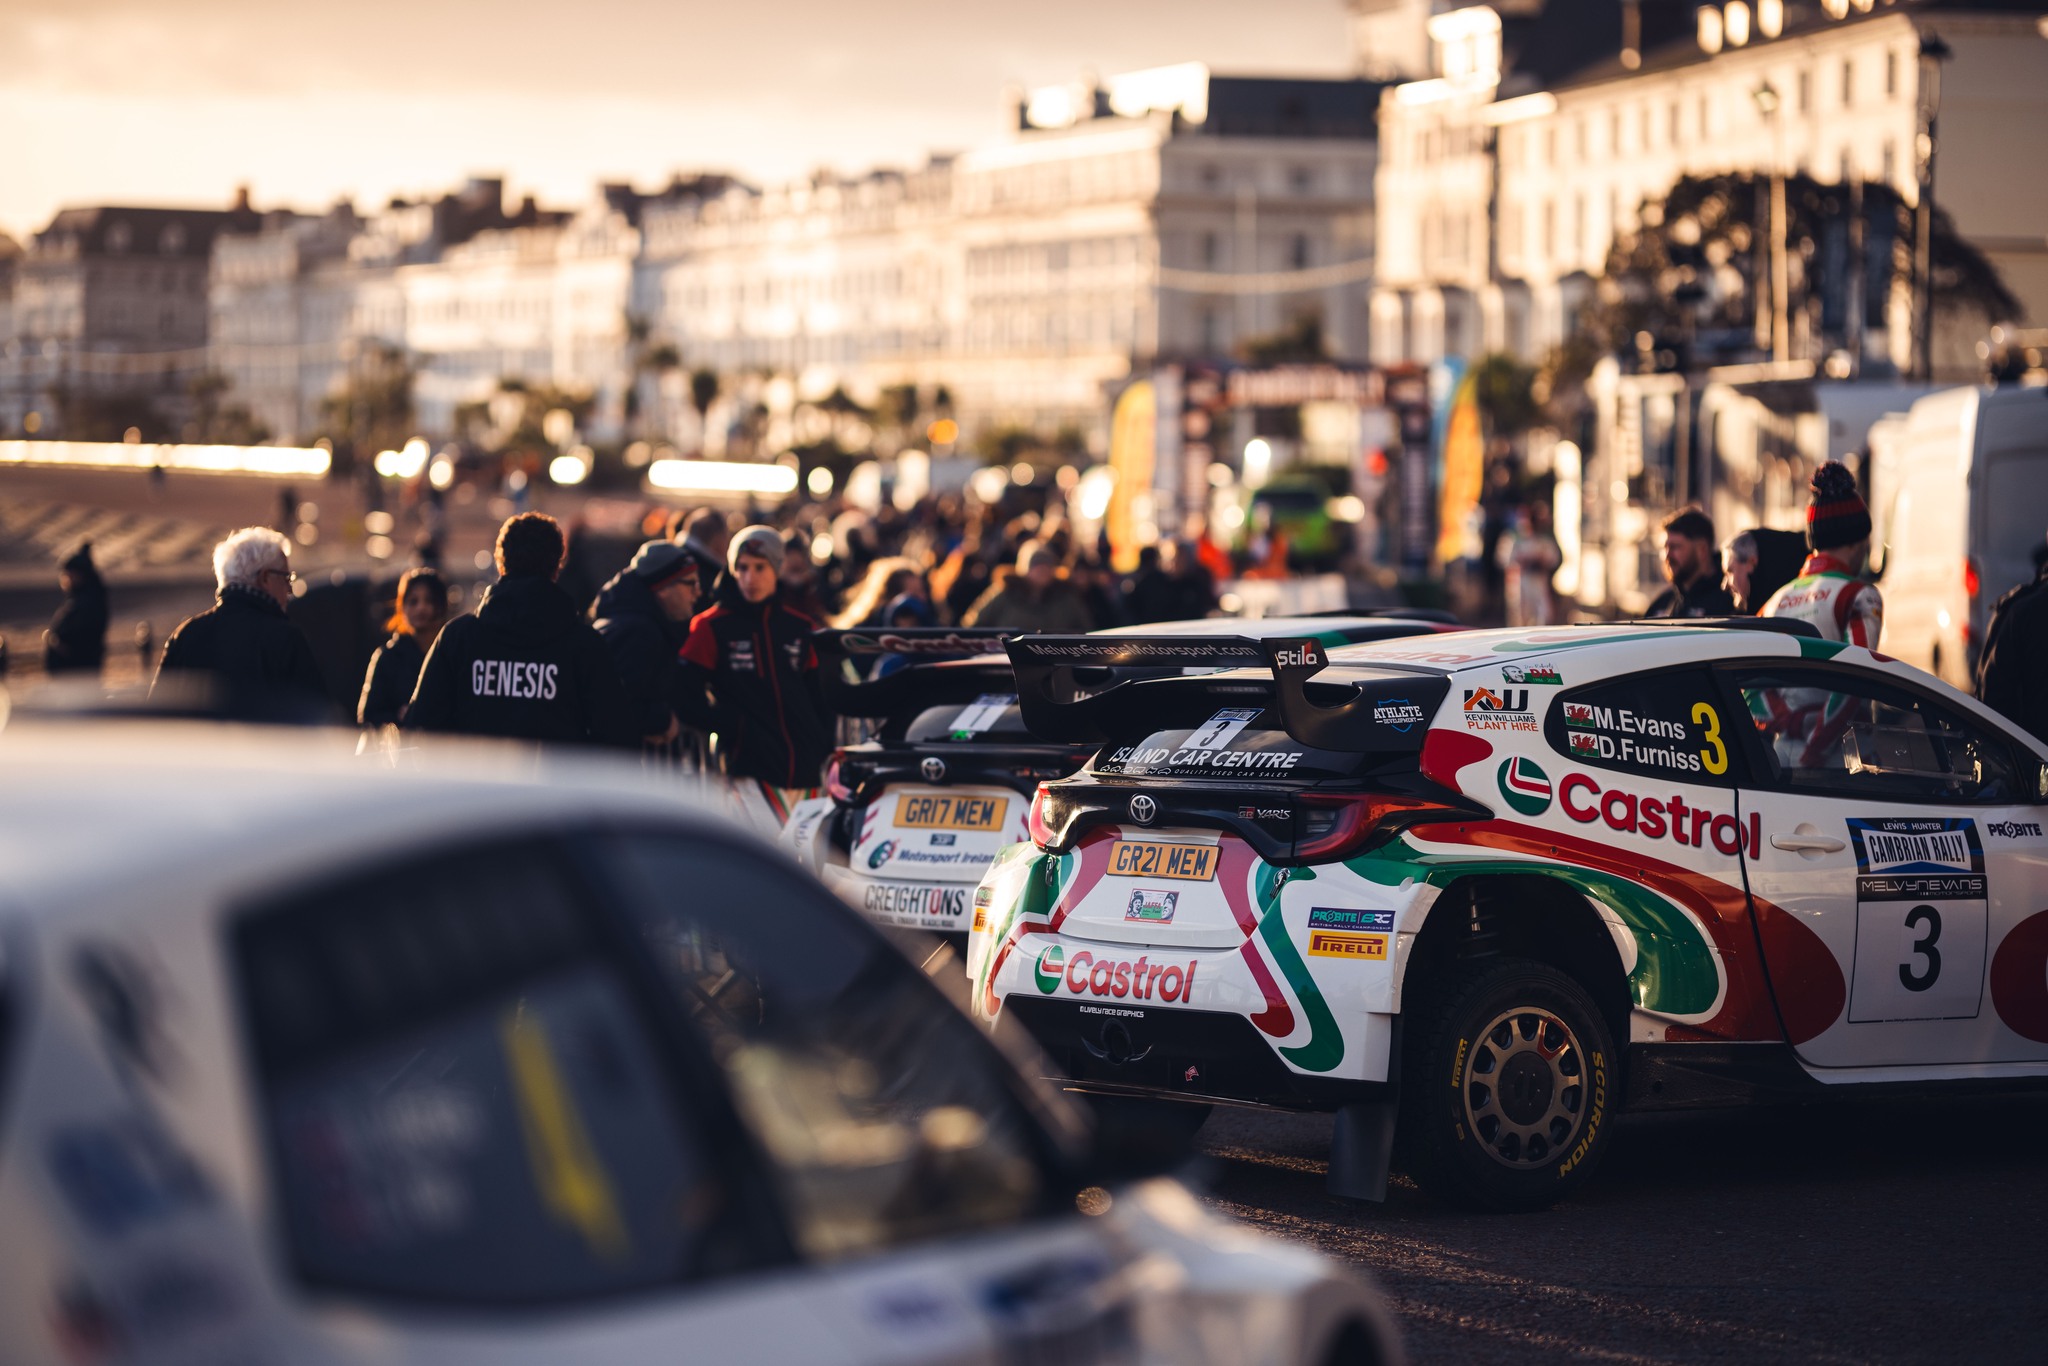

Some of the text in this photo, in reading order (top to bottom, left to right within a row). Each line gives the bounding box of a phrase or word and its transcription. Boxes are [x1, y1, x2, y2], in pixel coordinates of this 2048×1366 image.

[1277, 649, 1318, 667] Stilo
[471, 659, 559, 701] GENESIS
[1373, 705, 1423, 720] ATHLETE
[1383, 717, 1417, 725] DEVELOPMENT
[1493, 714, 1536, 723] WILLIAMS
[1594, 706, 1686, 740] M.Evans
[1199, 720, 1231, 747] 3
[1467, 721, 1539, 732] PLANT HIRE
[1691, 702, 1728, 775] 3
[1108, 747, 1304, 769] ISLAND CAR CENTRE
[1598, 735, 1701, 772] D.Furniss
[905, 797, 996, 826] GR17 MEM
[1239, 808, 1292, 820] GR YARIS
[1558, 773, 1761, 861] Castrol
[1882, 822, 1942, 831] LEWIS HUNTER
[1987, 820, 2043, 839] PROBITE
[898, 849, 996, 864] Motorsport Irelan
[1116, 845, 1210, 876] GR21 MEM
[1868, 835, 1966, 864] CAMBRIAN RALLY
[1861, 879, 1983, 893] MELVYNEVANS
[864, 884, 966, 917] CREIGHTONS
[1311, 910, 1392, 924] PROBITE BRC
[1312, 935, 1384, 955] PIRELLI
[1899, 904, 1942, 992] 3
[1066, 951, 1198, 1004] Castrol
[1559, 1051, 1606, 1178] SCORPION
